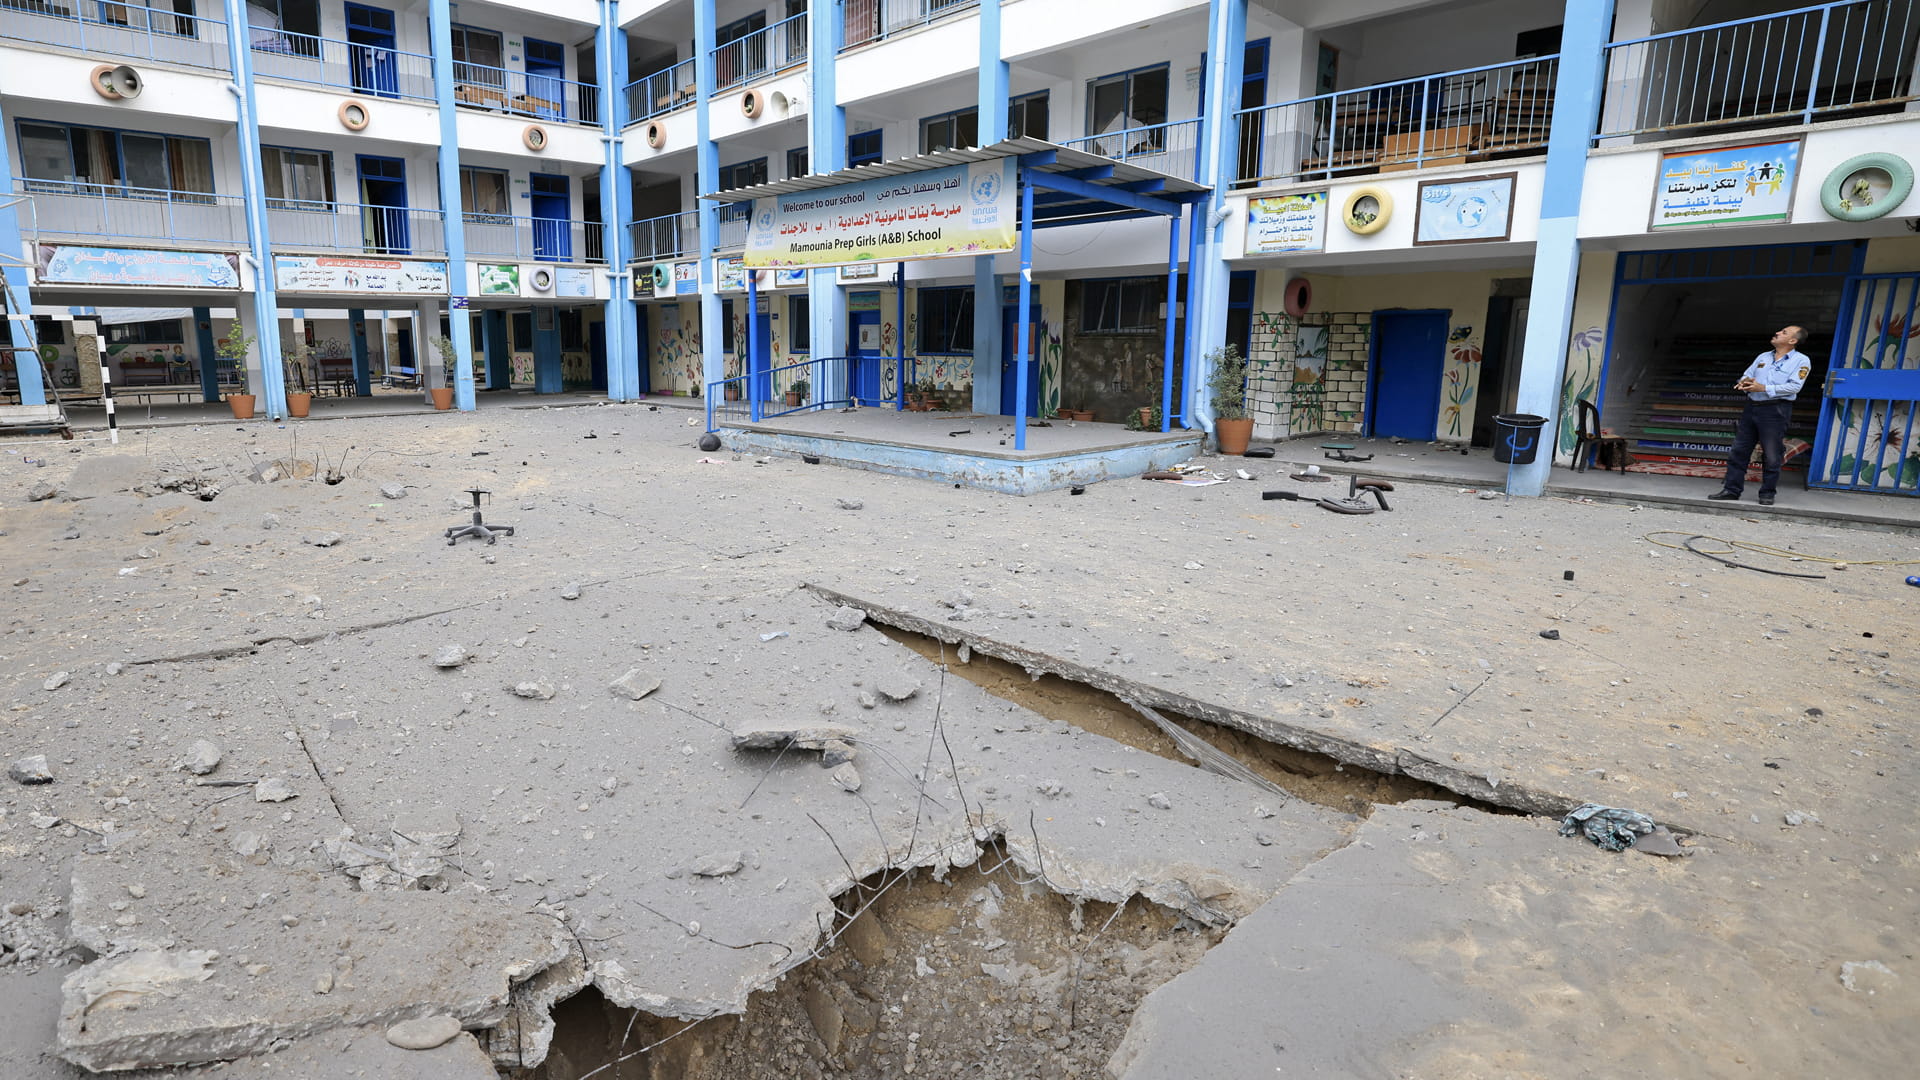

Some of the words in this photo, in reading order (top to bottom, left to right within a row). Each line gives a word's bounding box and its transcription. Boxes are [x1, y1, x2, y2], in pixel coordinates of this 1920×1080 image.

[1714, 160, 1747, 173] كلنا
[1665, 168, 1692, 179] بيد
[912, 183, 941, 194] وسهلا
[1668, 183, 1709, 193] مدرستنا
[1711, 178, 1737, 192] لتكن
[877, 188, 891, 203] في
[892, 185, 911, 199] بكم
[783, 201, 815, 213] Welcome
[816, 199, 824, 208] to
[825, 198, 837, 207] our
[839, 191, 865, 205] school
[1663, 196, 1710, 210] نظيفة
[1713, 195, 1743, 207] بيئة
[908, 205, 929, 221] بنات
[930, 203, 962, 219] مدرسة
[1308, 214, 1316, 223] مع
[1260, 226, 1290, 236] الاحترام
[790, 240, 833, 253] Mamounia
[834, 239, 854, 251] Prep
[856, 235, 876, 248] Girls
[878, 231, 905, 247] (A&B)
[907, 227, 941, 242] School
[1672, 442, 1680, 450] If
[1682, 443, 1705, 451] You
[1707, 444, 1733, 453] Wan
[1669, 456, 1702, 465] النجاح
